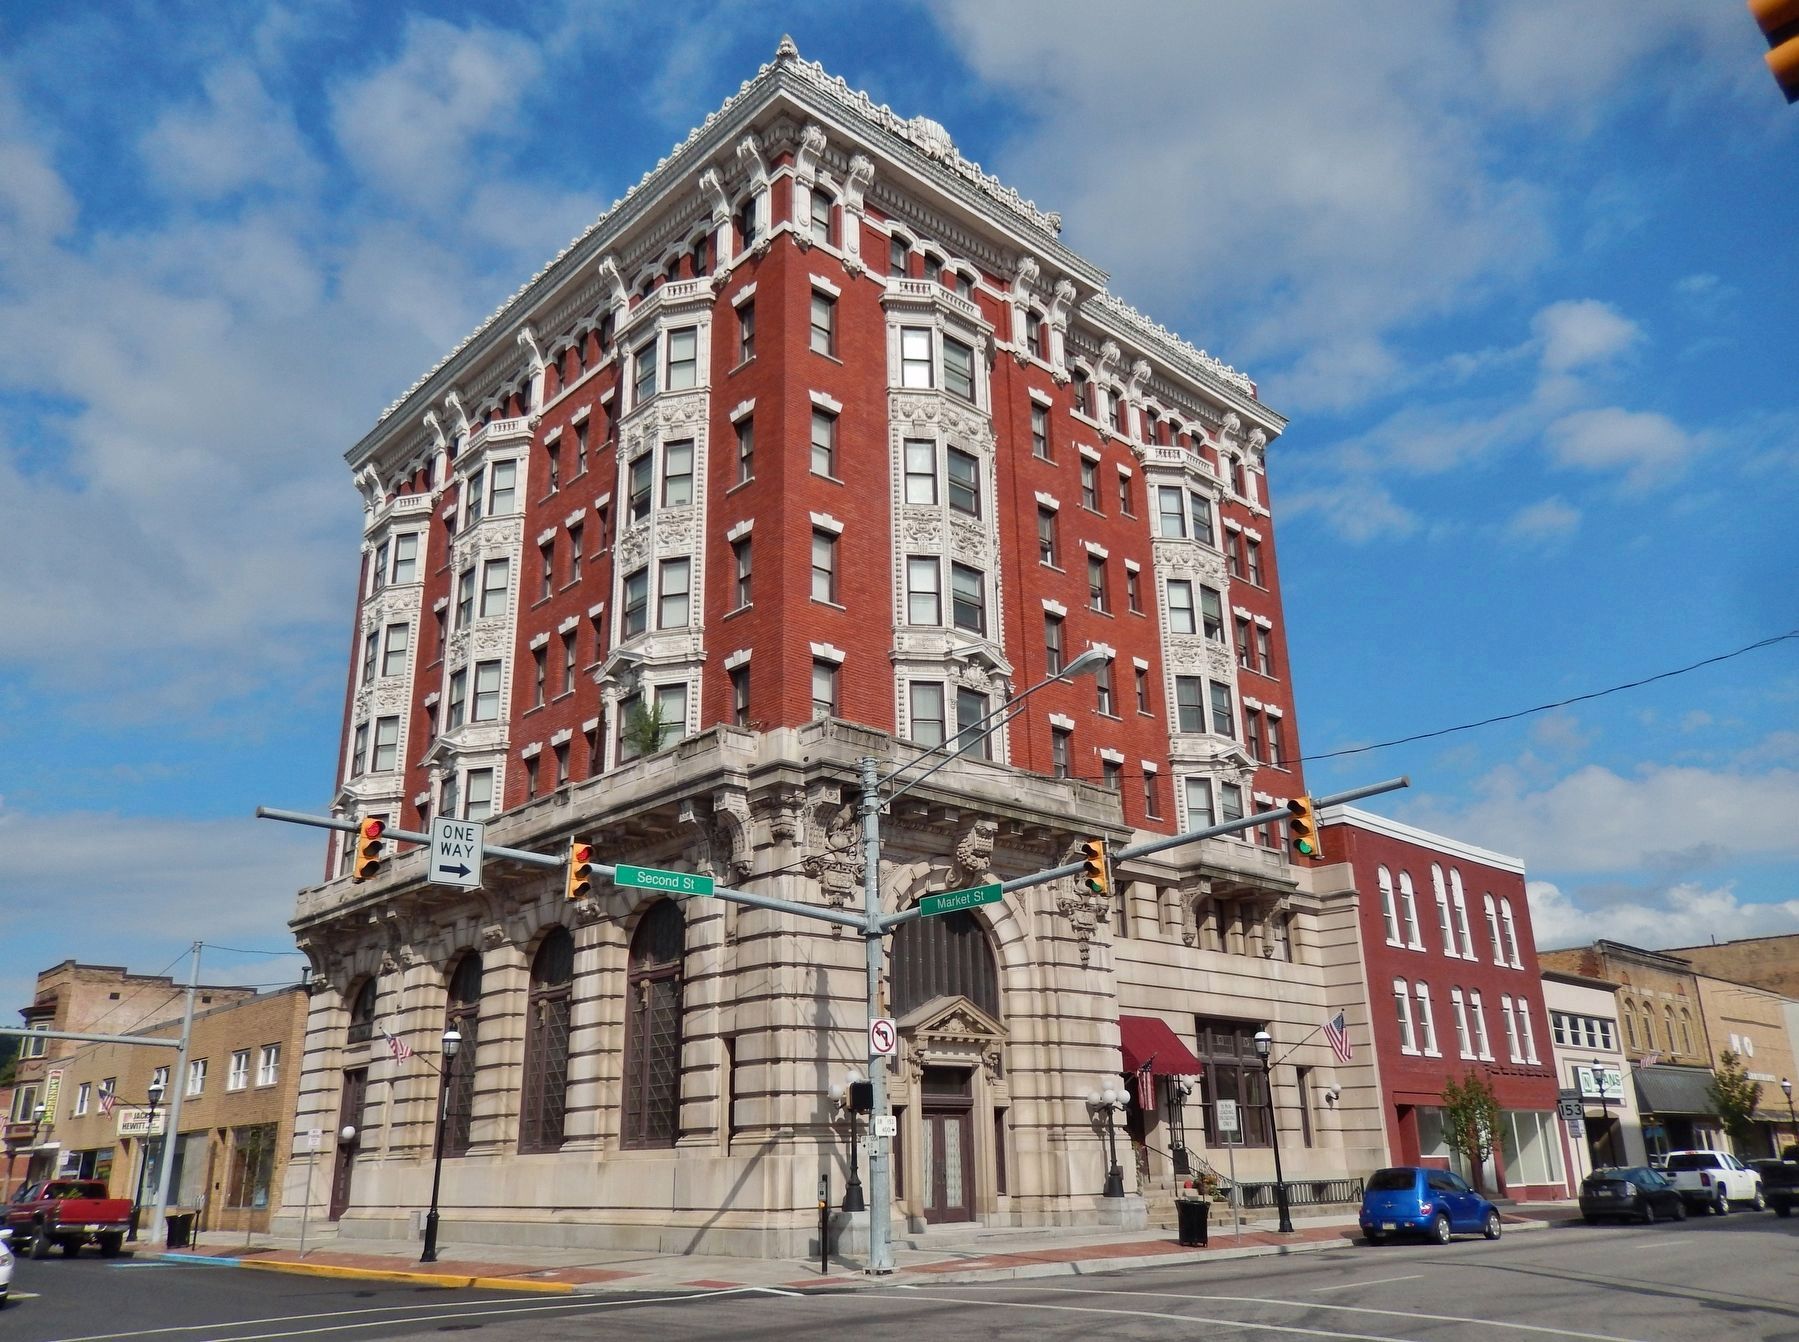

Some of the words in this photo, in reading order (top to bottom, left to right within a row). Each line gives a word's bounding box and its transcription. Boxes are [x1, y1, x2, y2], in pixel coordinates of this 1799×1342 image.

[443, 825, 475, 842] ONE
[440, 842, 475, 858] WAY
[637, 871, 679, 887] Second
[683, 877, 695, 890] St
[937, 893, 970, 909] Market
[973, 891, 985, 902] St
[1560, 1104, 1582, 1116] 153
[122, 1122, 146, 1130] HEWITT
